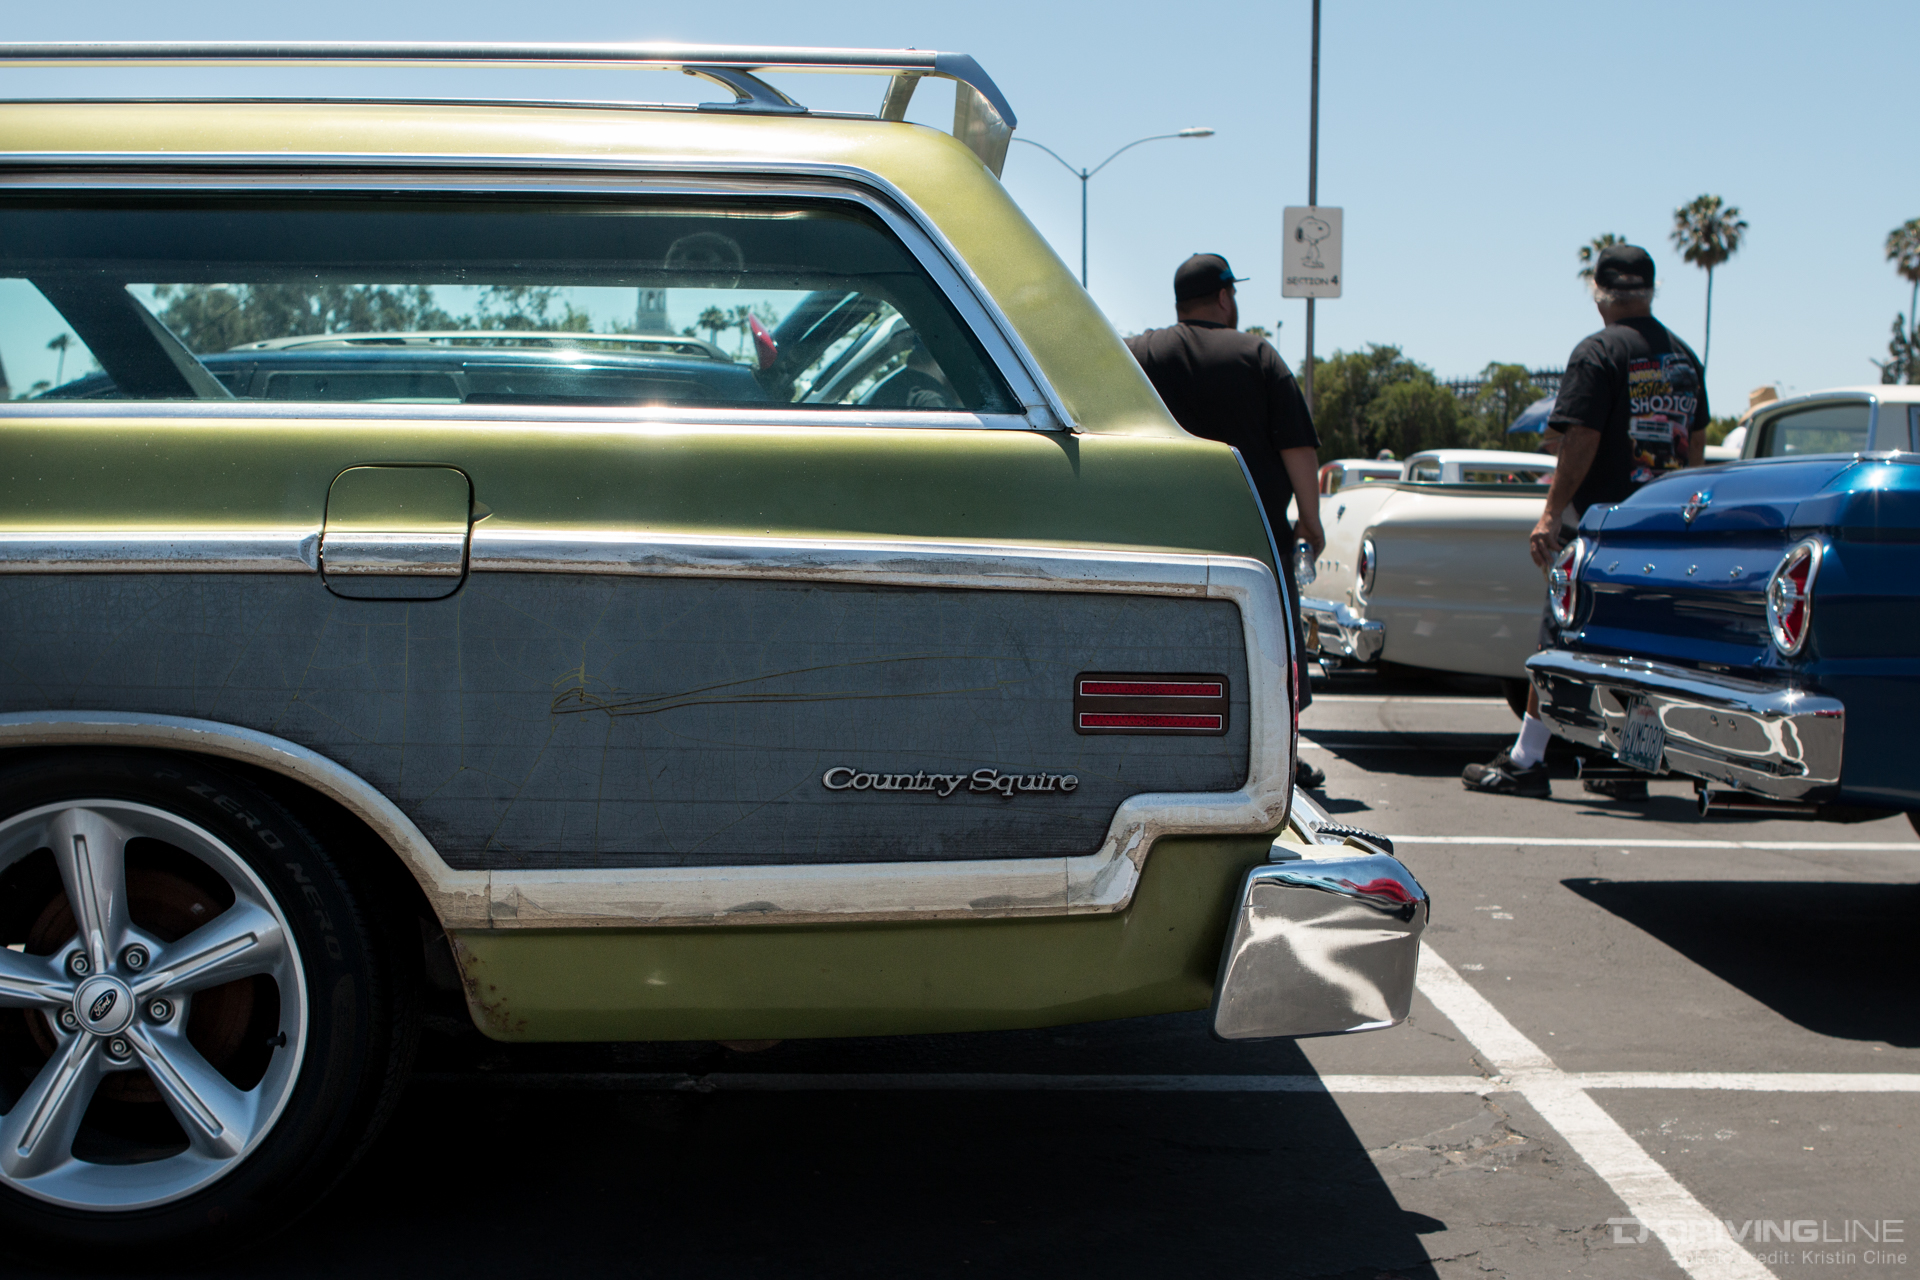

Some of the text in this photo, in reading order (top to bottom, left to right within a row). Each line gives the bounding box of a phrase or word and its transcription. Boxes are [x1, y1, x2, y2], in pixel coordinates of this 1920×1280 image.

[1286, 275, 1338, 286] SECTION 4
[822, 766, 1079, 796] Country Squire
[186, 780, 286, 850] ZERO
[285, 862, 343, 961] NERO
[93, 995, 111, 1017] Ford
